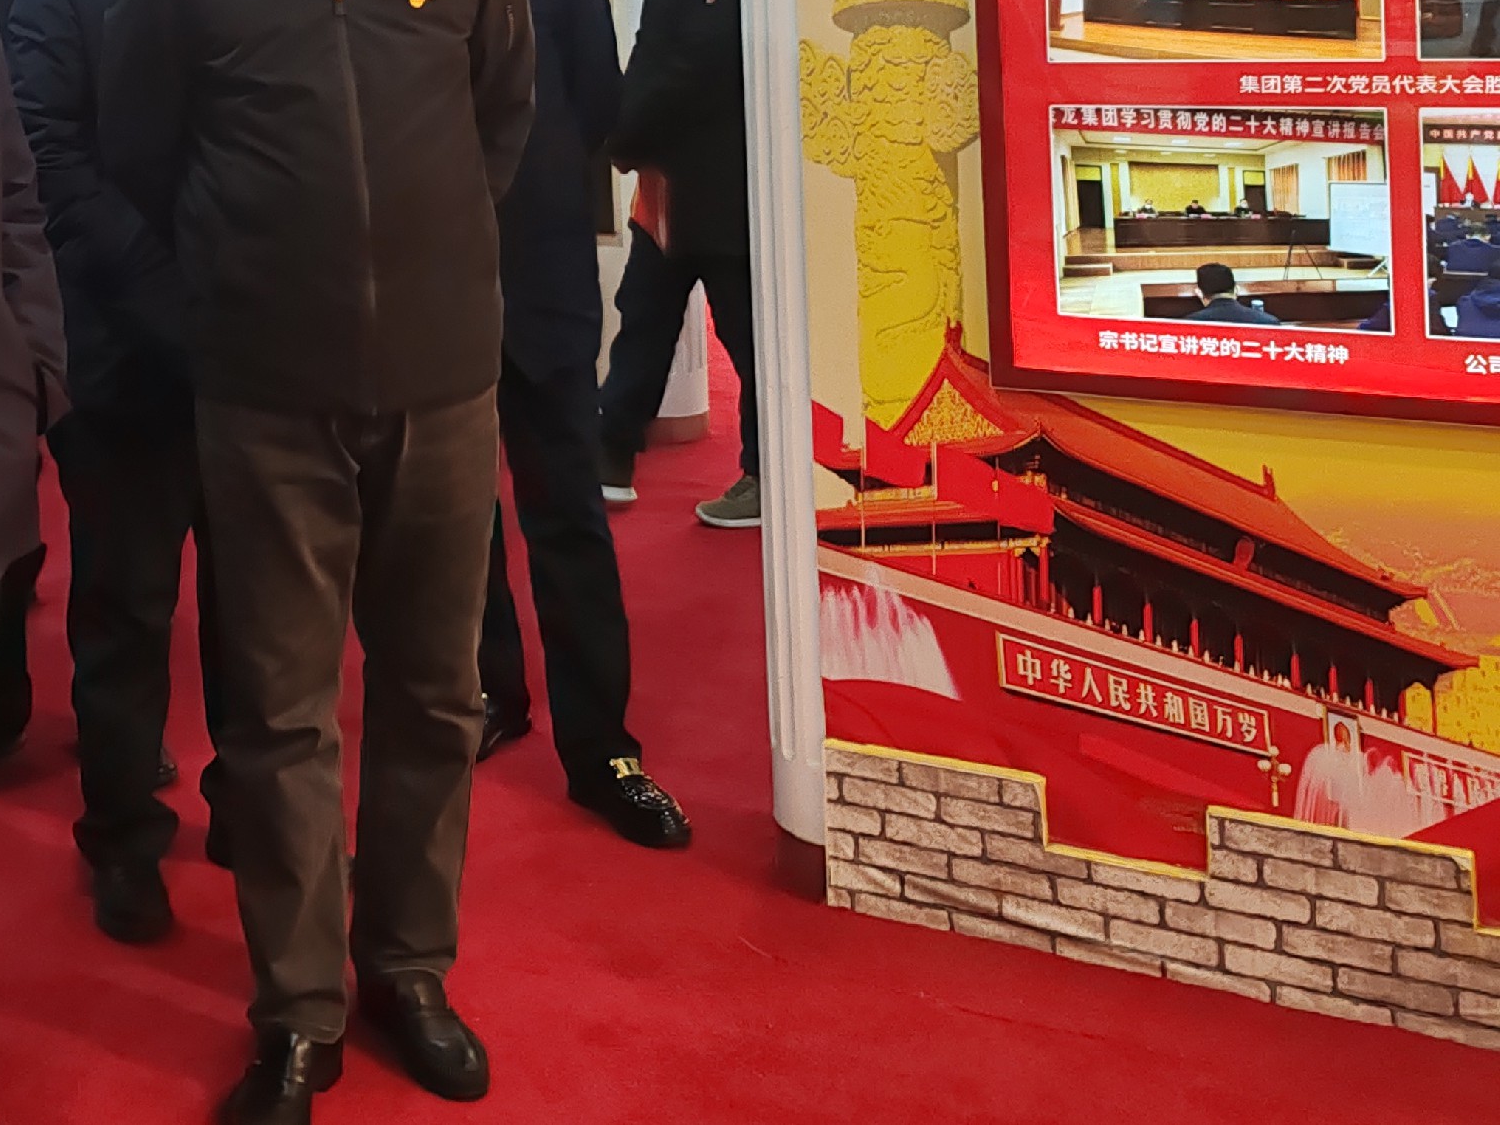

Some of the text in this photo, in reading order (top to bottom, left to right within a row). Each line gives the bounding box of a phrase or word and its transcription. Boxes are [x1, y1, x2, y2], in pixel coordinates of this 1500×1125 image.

[1240, 75, 1500, 94] 集团第二次党员代表大会胜
[1098, 330, 1349, 364] 宗书记宣讲党的二十大精神
[1017, 650, 1257, 742] 中华人民共和国万岁
